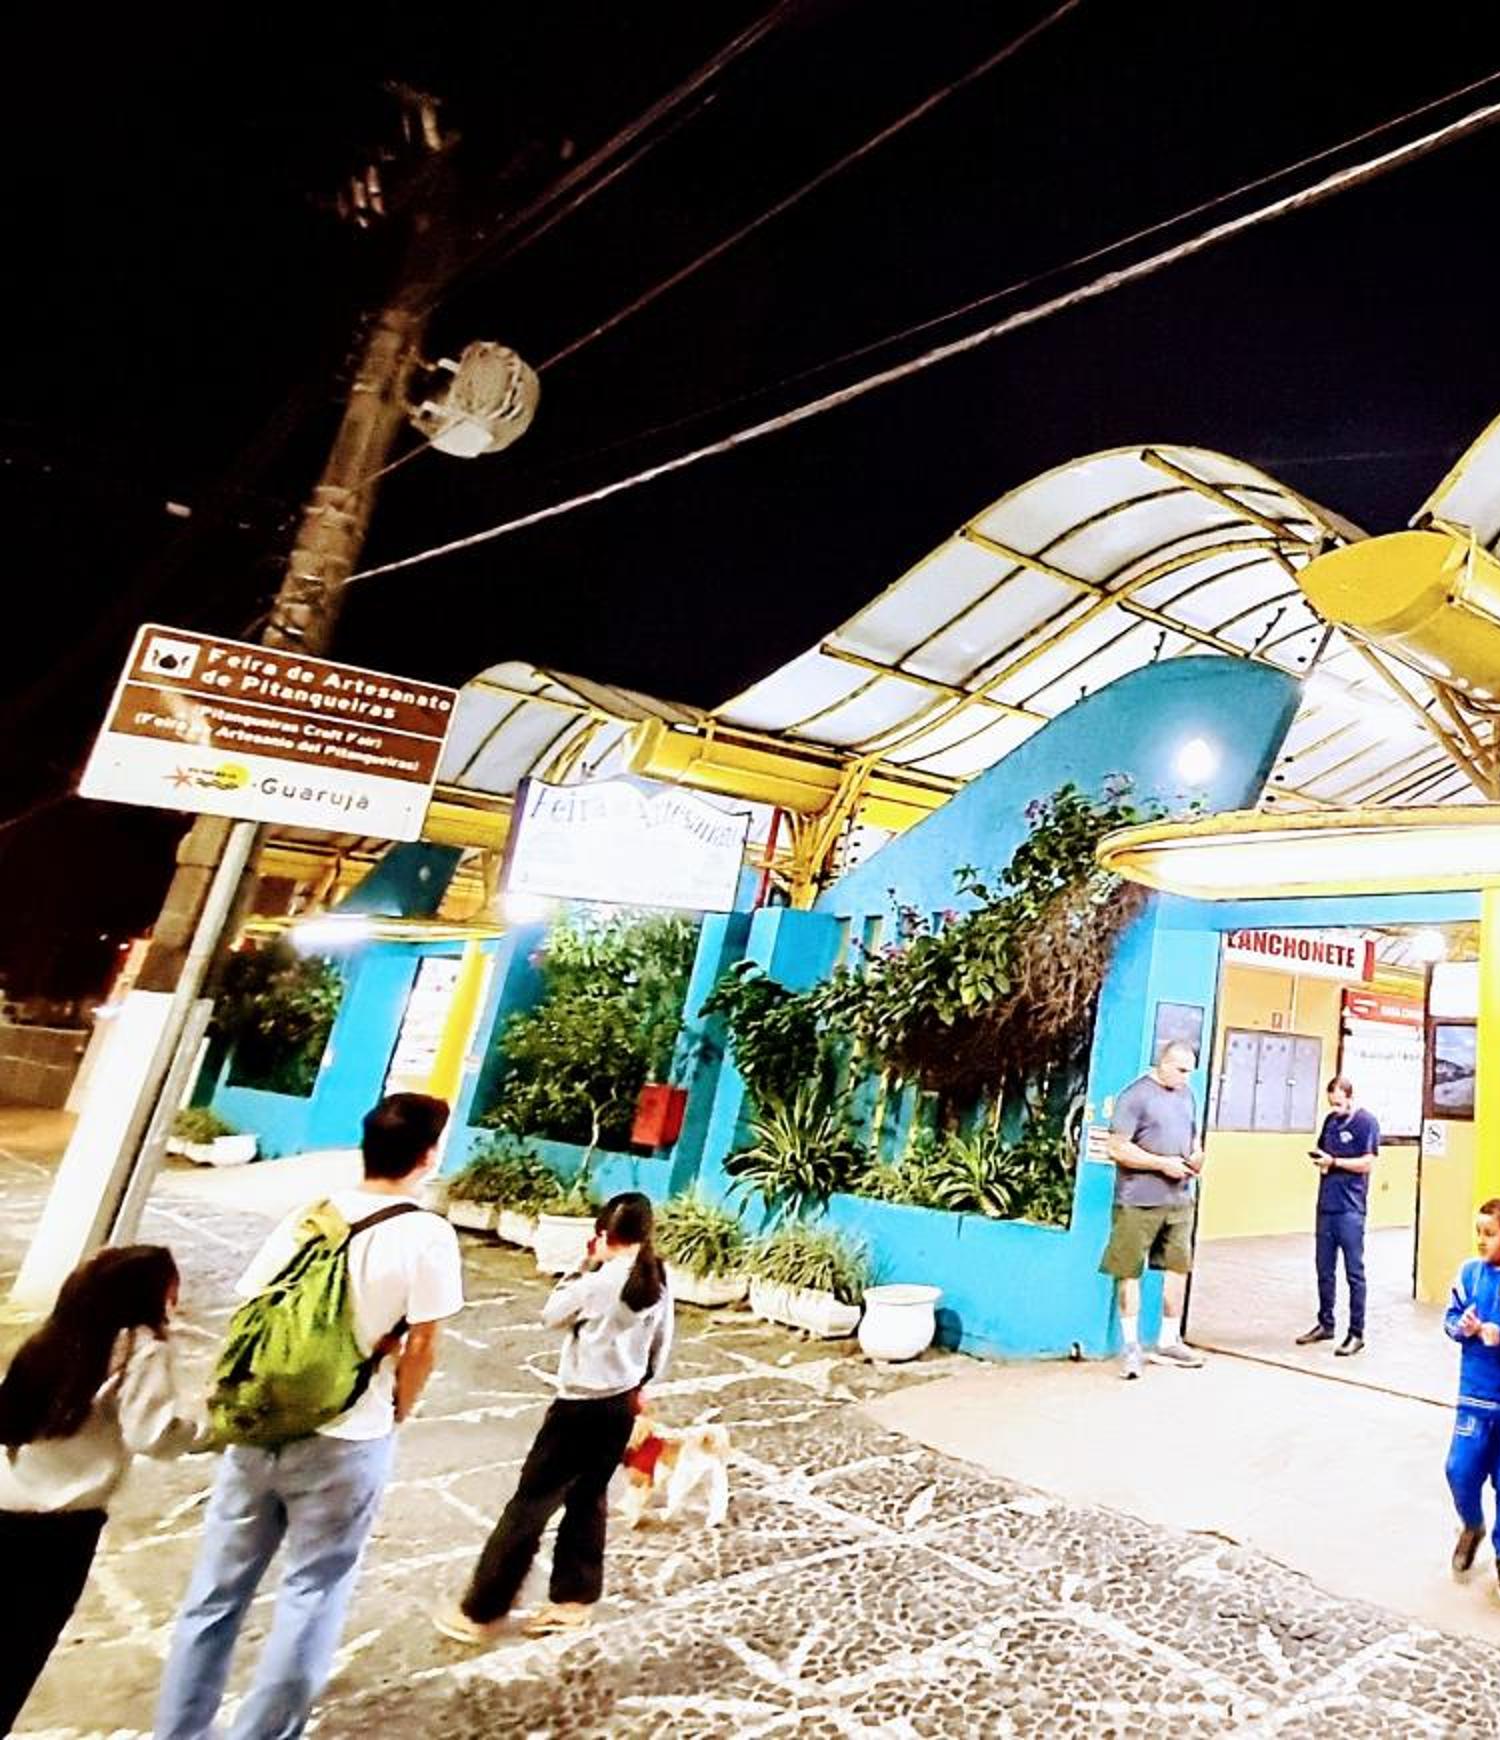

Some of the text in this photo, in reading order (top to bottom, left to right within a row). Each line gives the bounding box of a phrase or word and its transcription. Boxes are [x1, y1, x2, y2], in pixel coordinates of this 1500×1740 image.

[200, 670, 397, 720] de Pitangueiras
[207, 647, 451, 712] Feira de Artesanato
[1226, 929, 1356, 969] LANCHONETE
